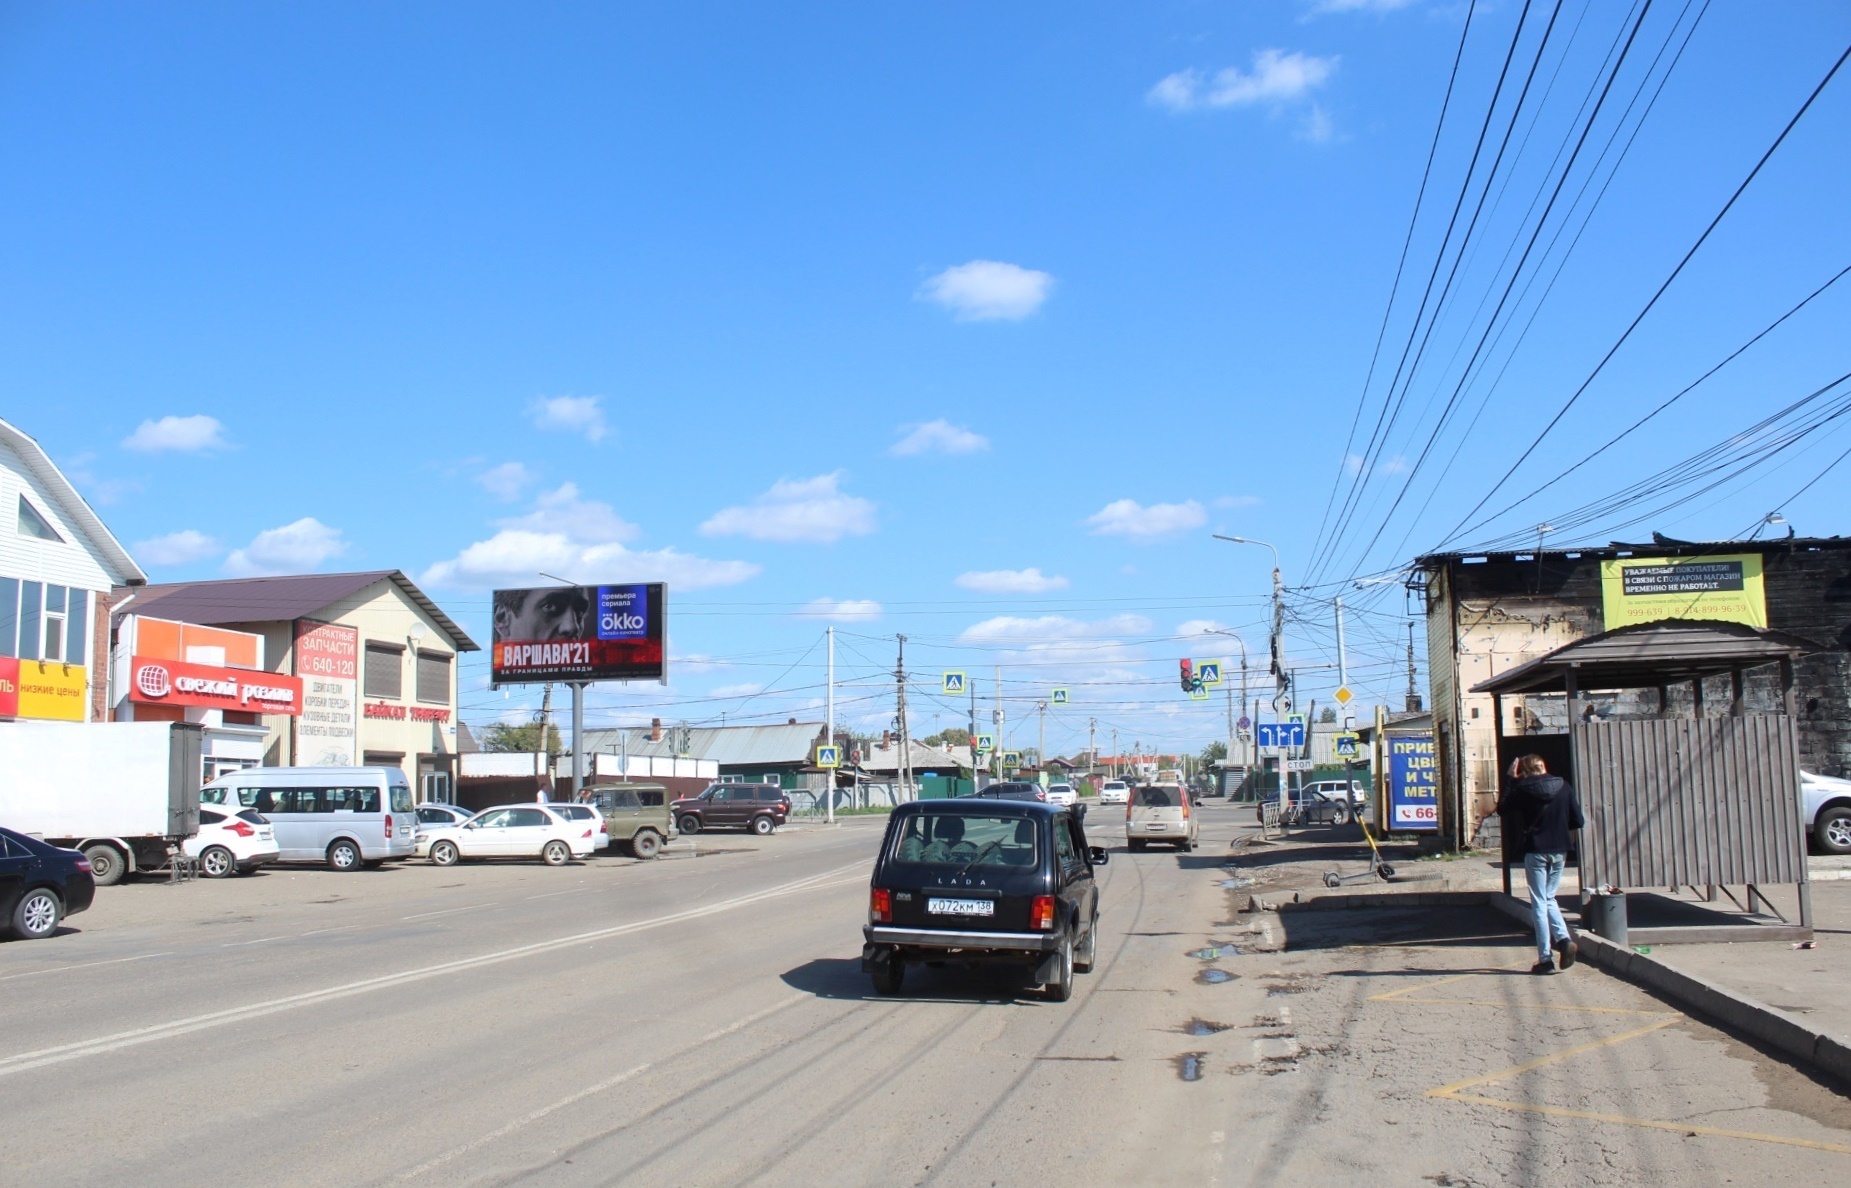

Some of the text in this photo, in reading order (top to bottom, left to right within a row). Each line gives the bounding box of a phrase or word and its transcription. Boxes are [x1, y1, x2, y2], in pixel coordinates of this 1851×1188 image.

[1675, 564, 1730, 574] ПОКУПАТЕЛИ!
[1631, 576, 1656, 584] СВЯЗИ
[1663, 574, 1703, 583] ПОЖАРОМ
[1703, 572, 1741, 581] МАГАЗИН
[1625, 584, 1667, 593] ВРЕМЕННО
[1668, 583, 1679, 591] НЕ
[601, 600, 631, 608] сериала
[1627, 605, 1747, 617] 999-639 8-914-899-96-39
[302, 625, 355, 642] КОНТРАКТНЫЕ
[302, 637, 355, 656] ЗАПЧАСТИ
[503, 642, 590, 667] ВАРШАВА'21
[312, 656, 355, 676] 640-120
[512, 667, 559, 675] ГРАНИЦАМИ
[561, 665, 593, 673] ПРАВДЫ
[20, 684, 80, 697] низкие цены
[175, 676, 239, 697] свежий
[313, 681, 343, 694] ДВИГАТЕЛИ
[304, 696, 350, 709] КОРОБКИ ПЕРЕДАЧ
[303, 712, 351, 724] КУЗОВНЫЕ ДЕТАЛИ
[299, 725, 328, 736] ЭЛЕМЕНТЫ
[1287, 761, 1311, 769] СТОП
[1406, 771, 1417, 783] И
[937, 877, 987, 886] LADA
[975, 901, 992, 910] 138
